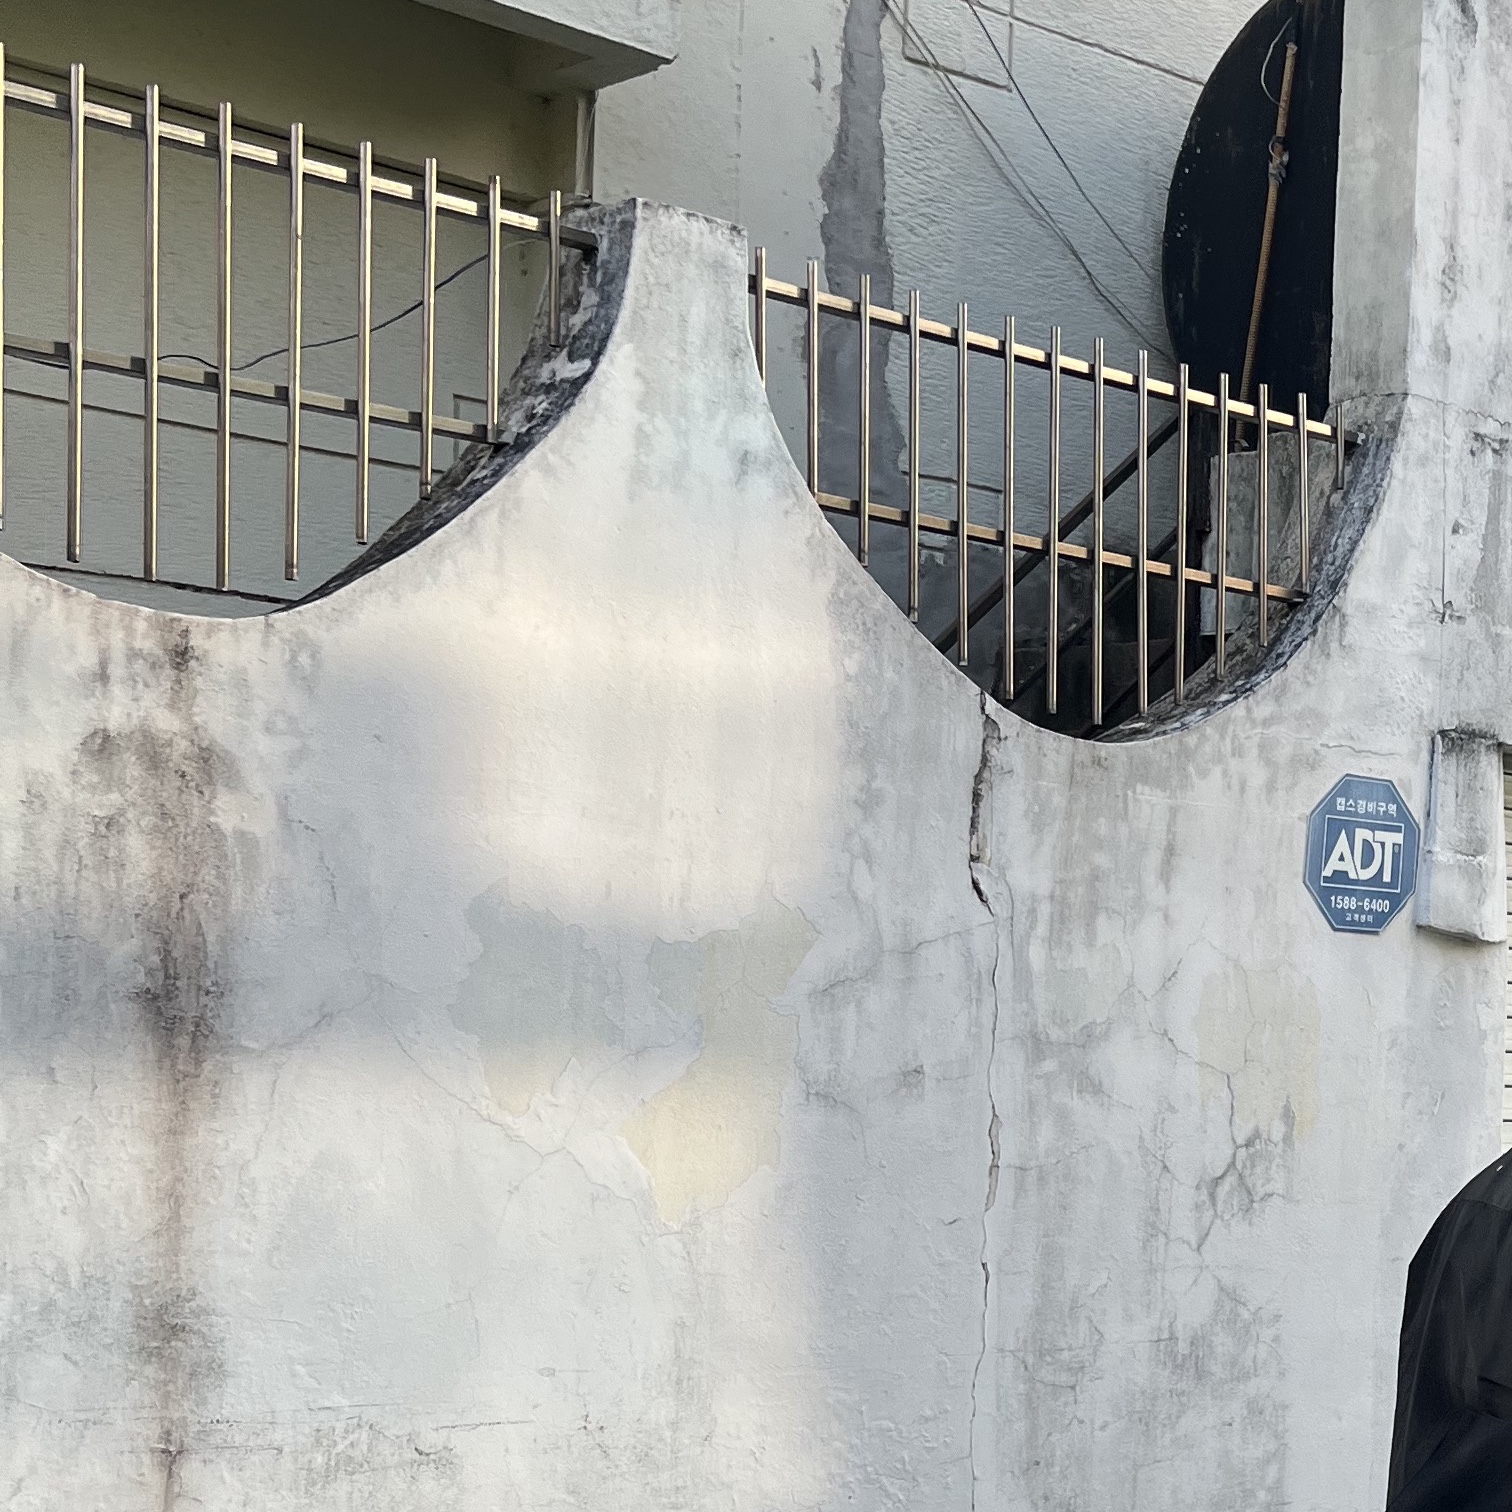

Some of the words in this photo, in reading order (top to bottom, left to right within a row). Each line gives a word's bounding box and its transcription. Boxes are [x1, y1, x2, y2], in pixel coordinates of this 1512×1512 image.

[1336, 796, 1397, 818] 캡스경비구역
[1323, 828, 1403, 883] ADT
[1330, 895, 1390, 913] 1588-6400
